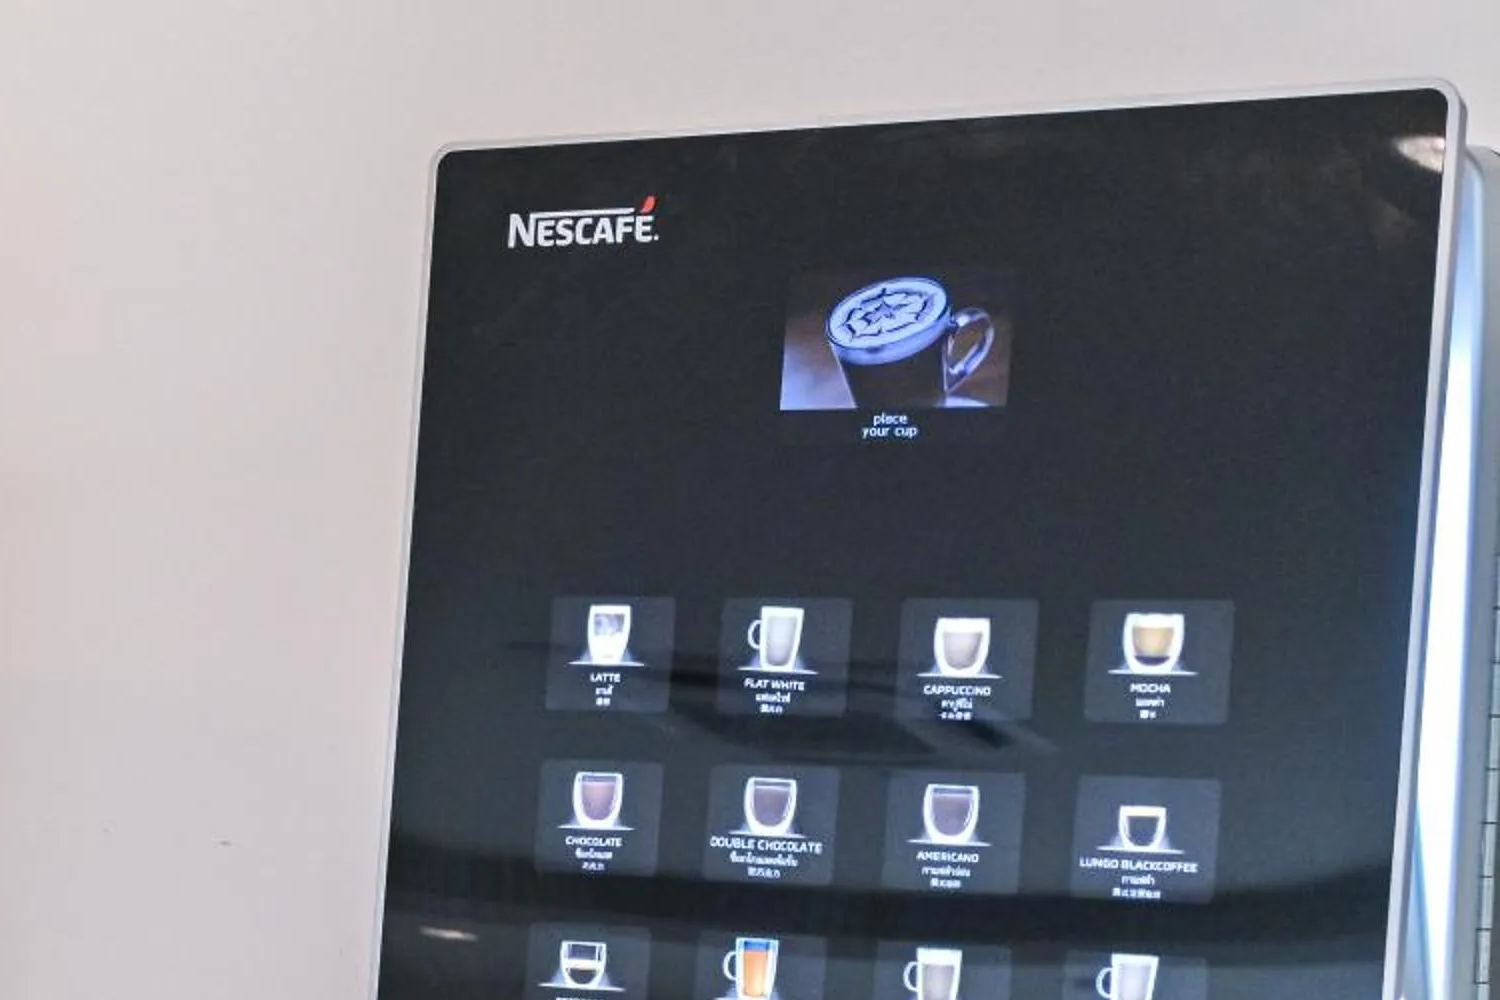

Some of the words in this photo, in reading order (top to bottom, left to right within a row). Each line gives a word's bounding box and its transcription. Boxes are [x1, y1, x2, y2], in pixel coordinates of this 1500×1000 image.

[873, 411, 909, 427] place
[862, 427, 890, 440] your
[894, 427, 919, 440] cup
[589, 672, 621, 683] LATTE
[743, 677, 769, 689] FLAT
[771, 679, 806, 691] WHITE
[923, 684, 992, 697] CAPPUCCINO
[1129, 682, 1171, 693] MOCHA
[565, 835, 623, 847] CHOCOLATE
[709, 835, 756, 849] DOUBLE
[756, 839, 823, 854] CHOCOLATE
[916, 850, 980, 863] AMERICANO
[1120, 859, 1199, 873] BLACKCOFFEE
